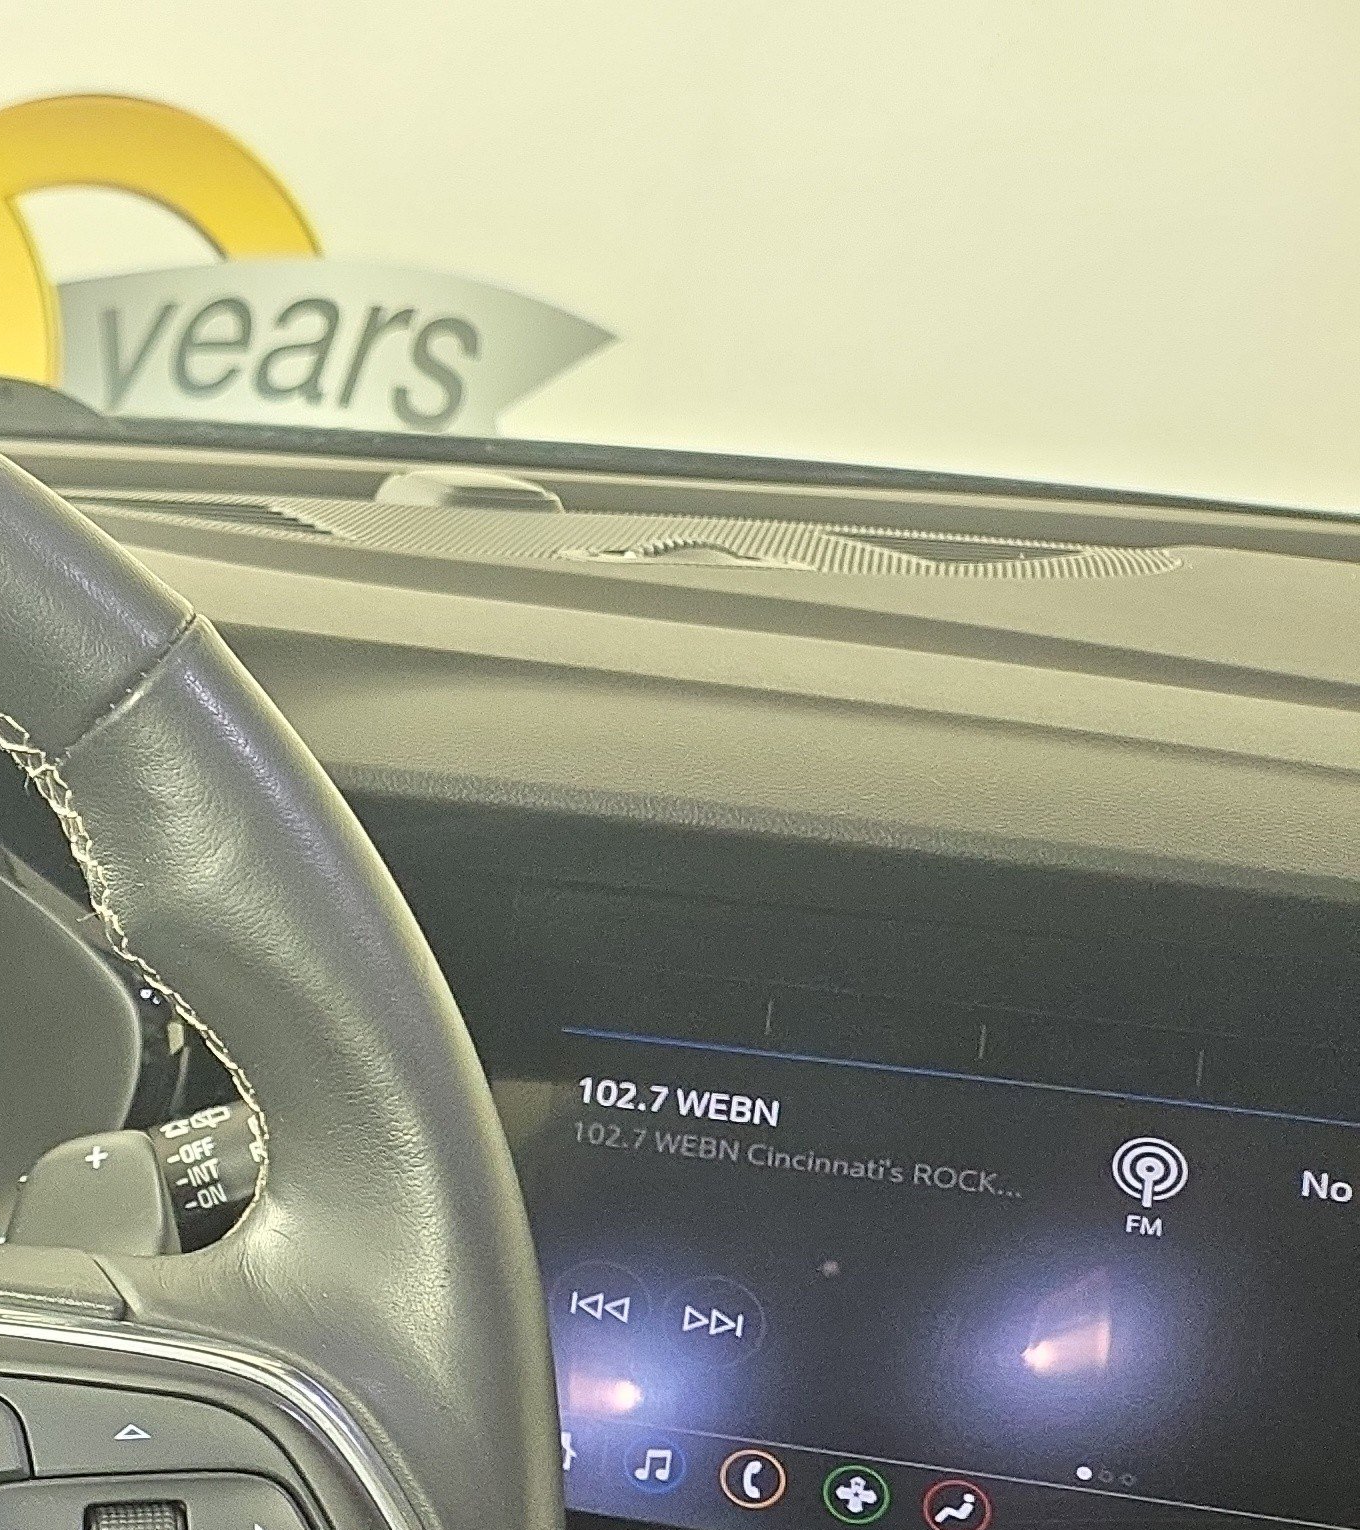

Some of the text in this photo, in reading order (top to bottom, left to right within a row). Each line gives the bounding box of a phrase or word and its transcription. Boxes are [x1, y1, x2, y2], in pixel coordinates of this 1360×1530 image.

[95, 290, 480, 438] years
[577, 1076, 781, 1128] 102.7 WEBN
[178, 1138, 215, 1164] OFF
[573, 1121, 648, 1151] 102.7
[654, 1131, 740, 1163] WEBN
[746, 1142, 904, 1184] Cincinnati's
[186, 1159, 219, 1187] INT
[1301, 1170, 1354, 1204] No
[197, 1185, 227, 1209] ON
[1125, 1214, 1164, 1238] FM
